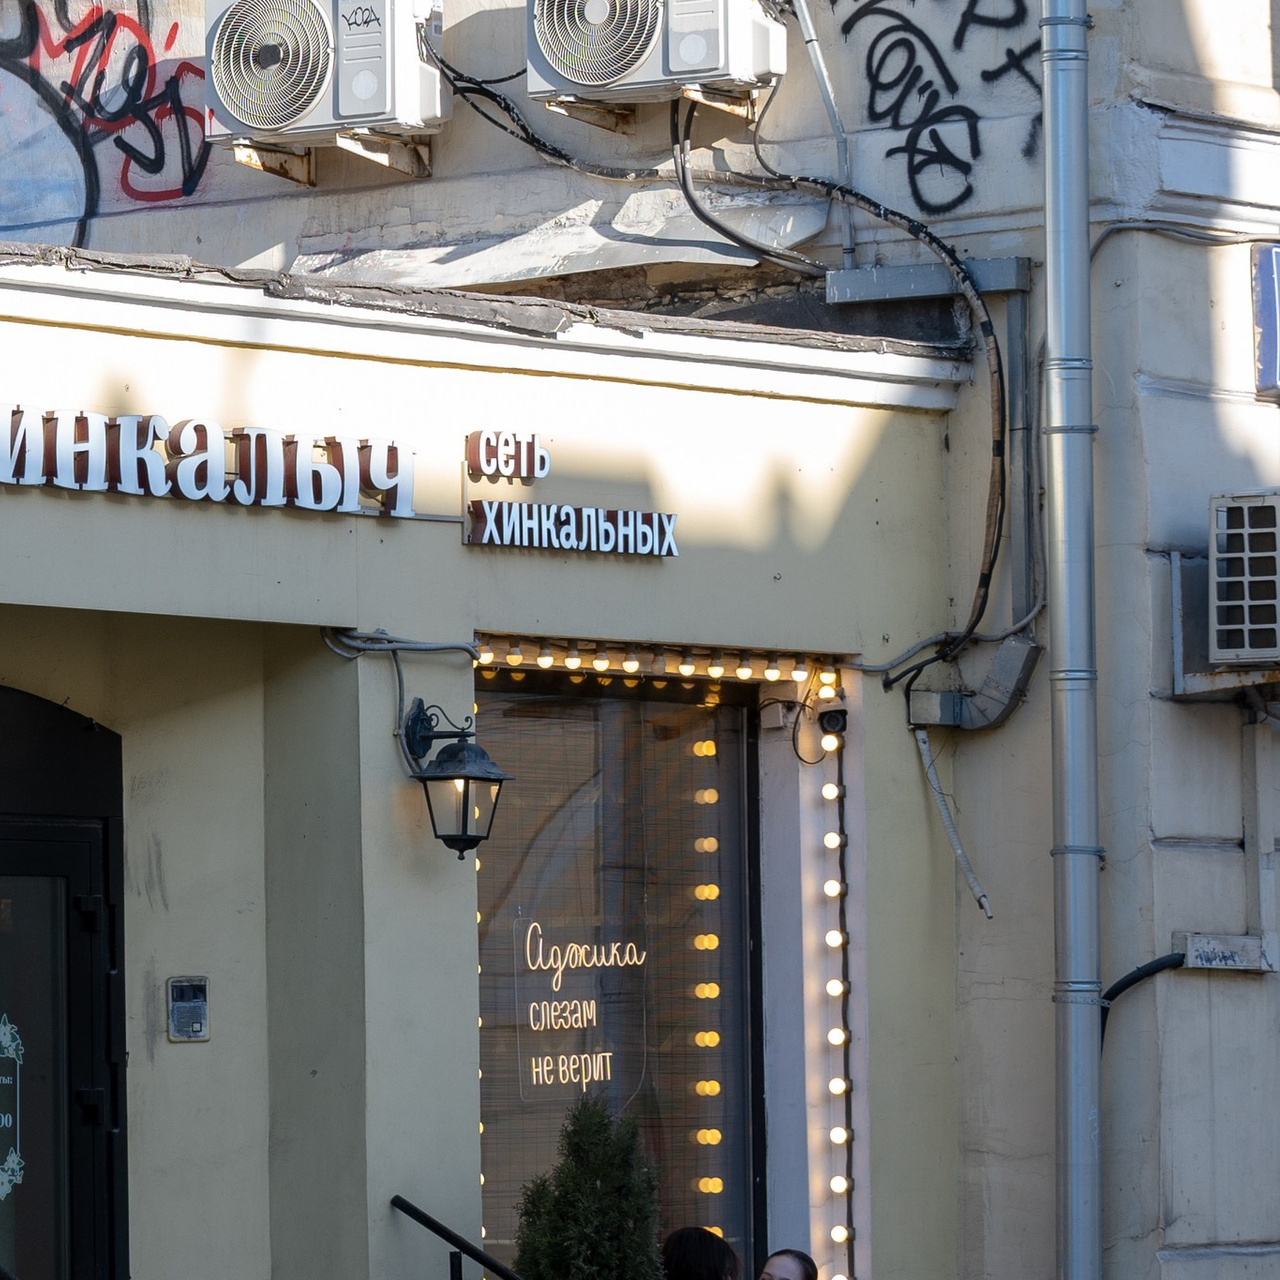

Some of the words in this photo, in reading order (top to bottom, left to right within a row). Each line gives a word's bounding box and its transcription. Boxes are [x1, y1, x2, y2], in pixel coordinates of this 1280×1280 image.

[473, 430, 551, 479] сеть
[476, 499, 679, 557] хинкальных
[526, 922, 647, 992] Аджика
[529, 1000, 597, 1031] слезам
[531, 1056, 554, 1085] не
[558, 1052, 613, 1093] верит
